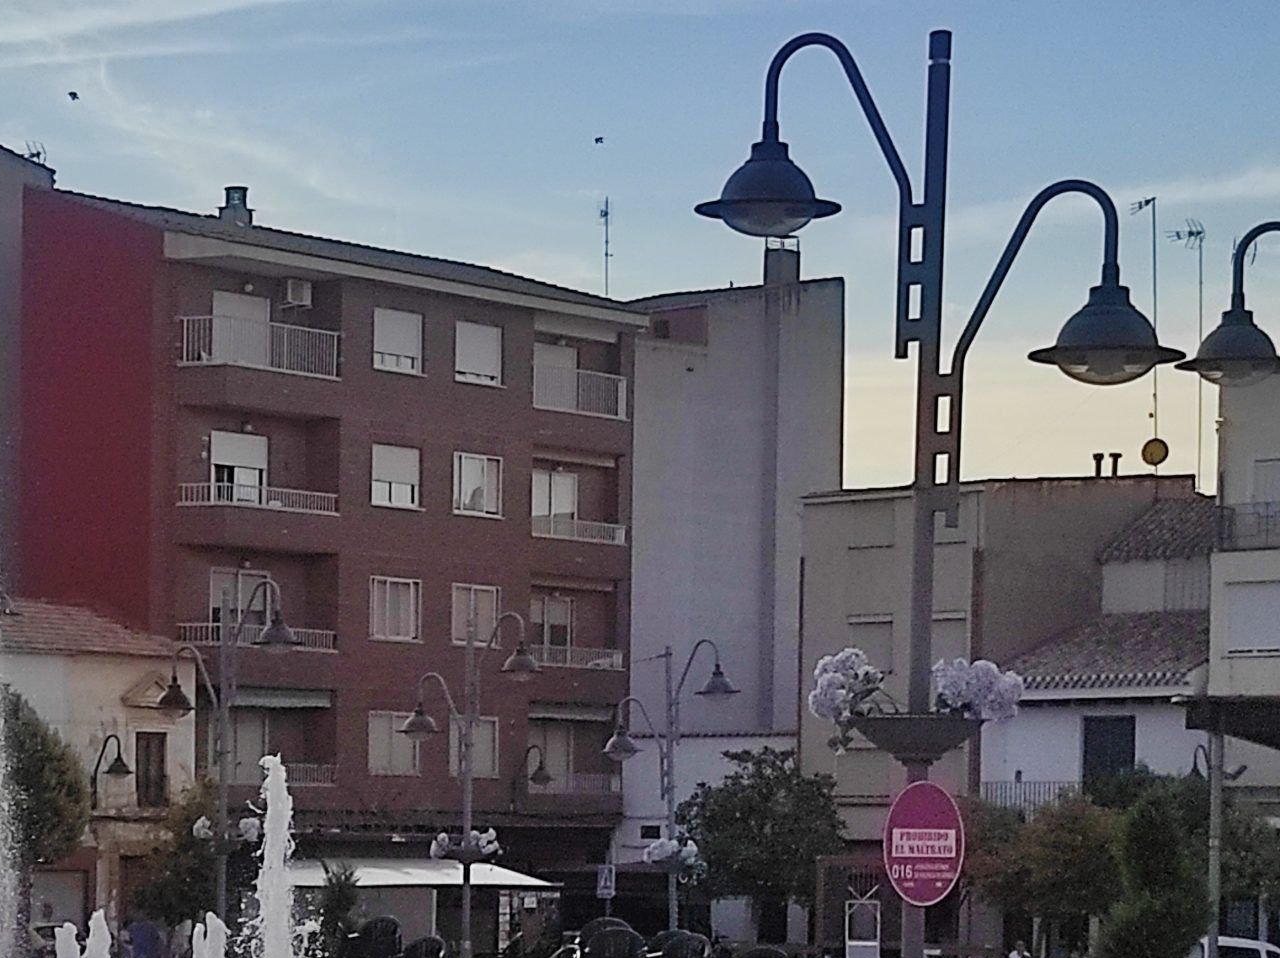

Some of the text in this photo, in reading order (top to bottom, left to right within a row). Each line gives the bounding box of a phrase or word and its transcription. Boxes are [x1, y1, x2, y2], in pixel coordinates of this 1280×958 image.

[900, 831, 948, 841] PROHIBIDO
[895, 845, 953, 854] EL MALTRATO
[892, 864, 913, 879] 016
